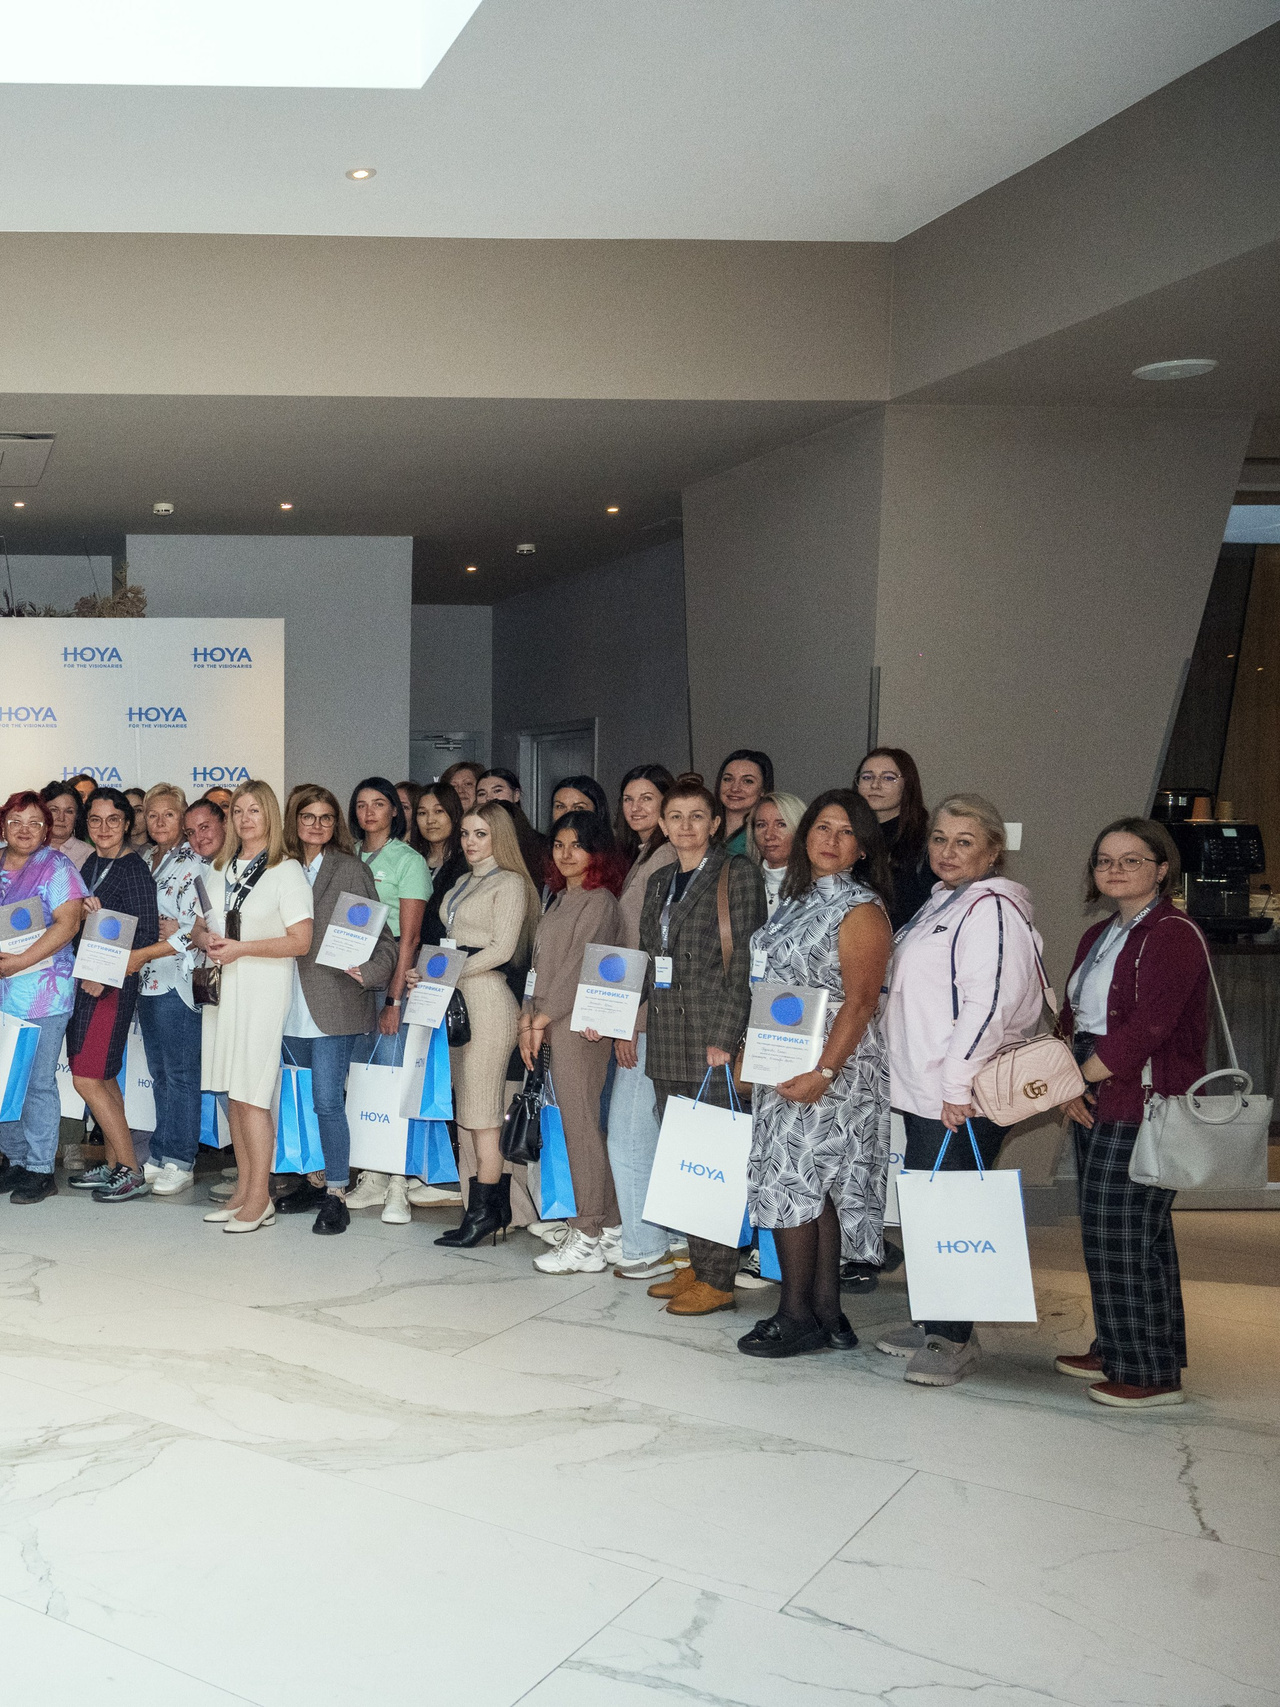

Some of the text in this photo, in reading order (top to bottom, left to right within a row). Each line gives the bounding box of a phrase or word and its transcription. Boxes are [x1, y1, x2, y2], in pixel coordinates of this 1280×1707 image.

[60, 647, 123, 662] HOYA
[189, 647, 253, 662] HOYA
[124, 707, 188, 722] HOYA
[190, 766, 252, 781] HOYA
[698, 857, 708, 871] HOYA
[1133, 907, 1151, 923] HOYA
[8, 934, 41, 947] СЕРТИФИКАТ
[333, 928, 368, 942] СЕРТИФИКАТ
[893, 930, 909, 944] HOYA
[87, 943, 122, 955] СЕРТИФИКАТ
[417, 984, 445, 993] ЕРТИФИКАТ
[586, 988, 630, 999] СЕРТИФИКАТ
[757, 1032, 810, 1045] СЕРТИФИКАТ
[56, 1062, 71, 1073] OYA
[360, 1110, 390, 1124] HOYA
[679, 1158, 726, 1184] HOYA
[936, 1240, 997, 1255] HOYA
